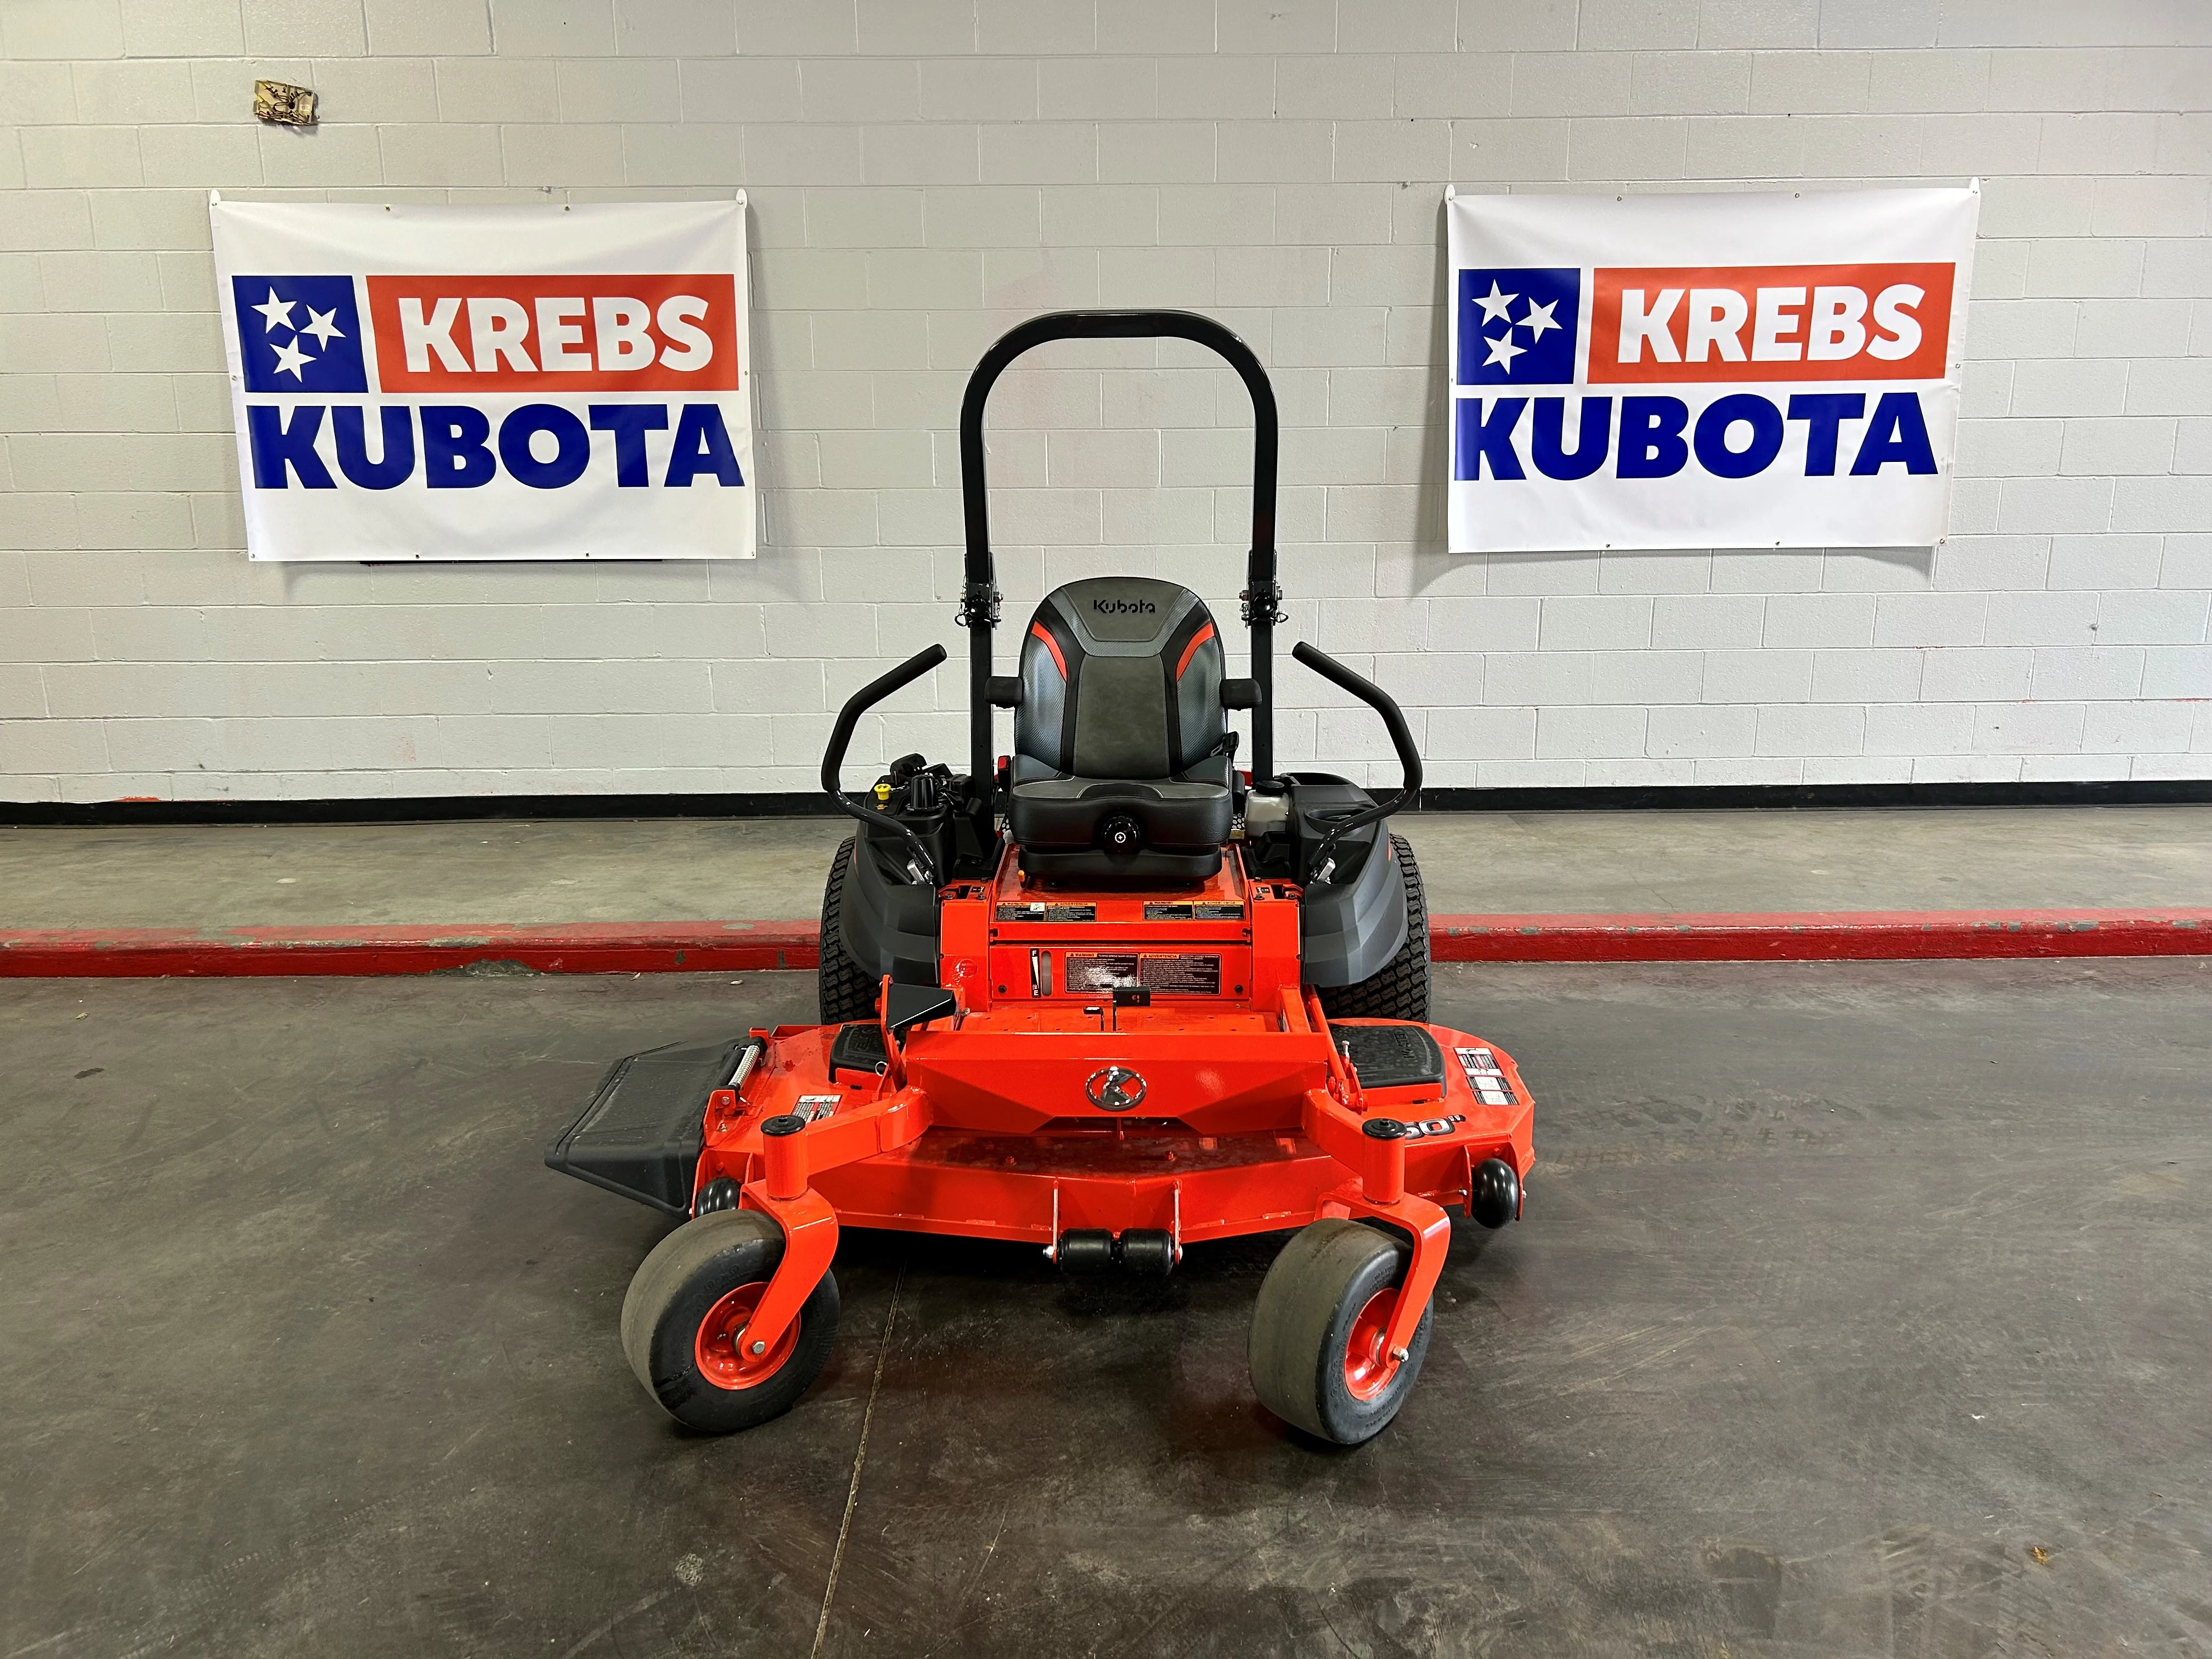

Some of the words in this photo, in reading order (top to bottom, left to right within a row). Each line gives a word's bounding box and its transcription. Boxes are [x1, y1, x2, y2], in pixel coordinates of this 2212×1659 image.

[398, 295, 713, 373] KREBS
[1617, 284, 1926, 363] KREBS
[246, 403, 744, 489] KUBOTA
[1454, 392, 1938, 481] KUBOTA
[1093, 599, 1155, 614] Kubota
